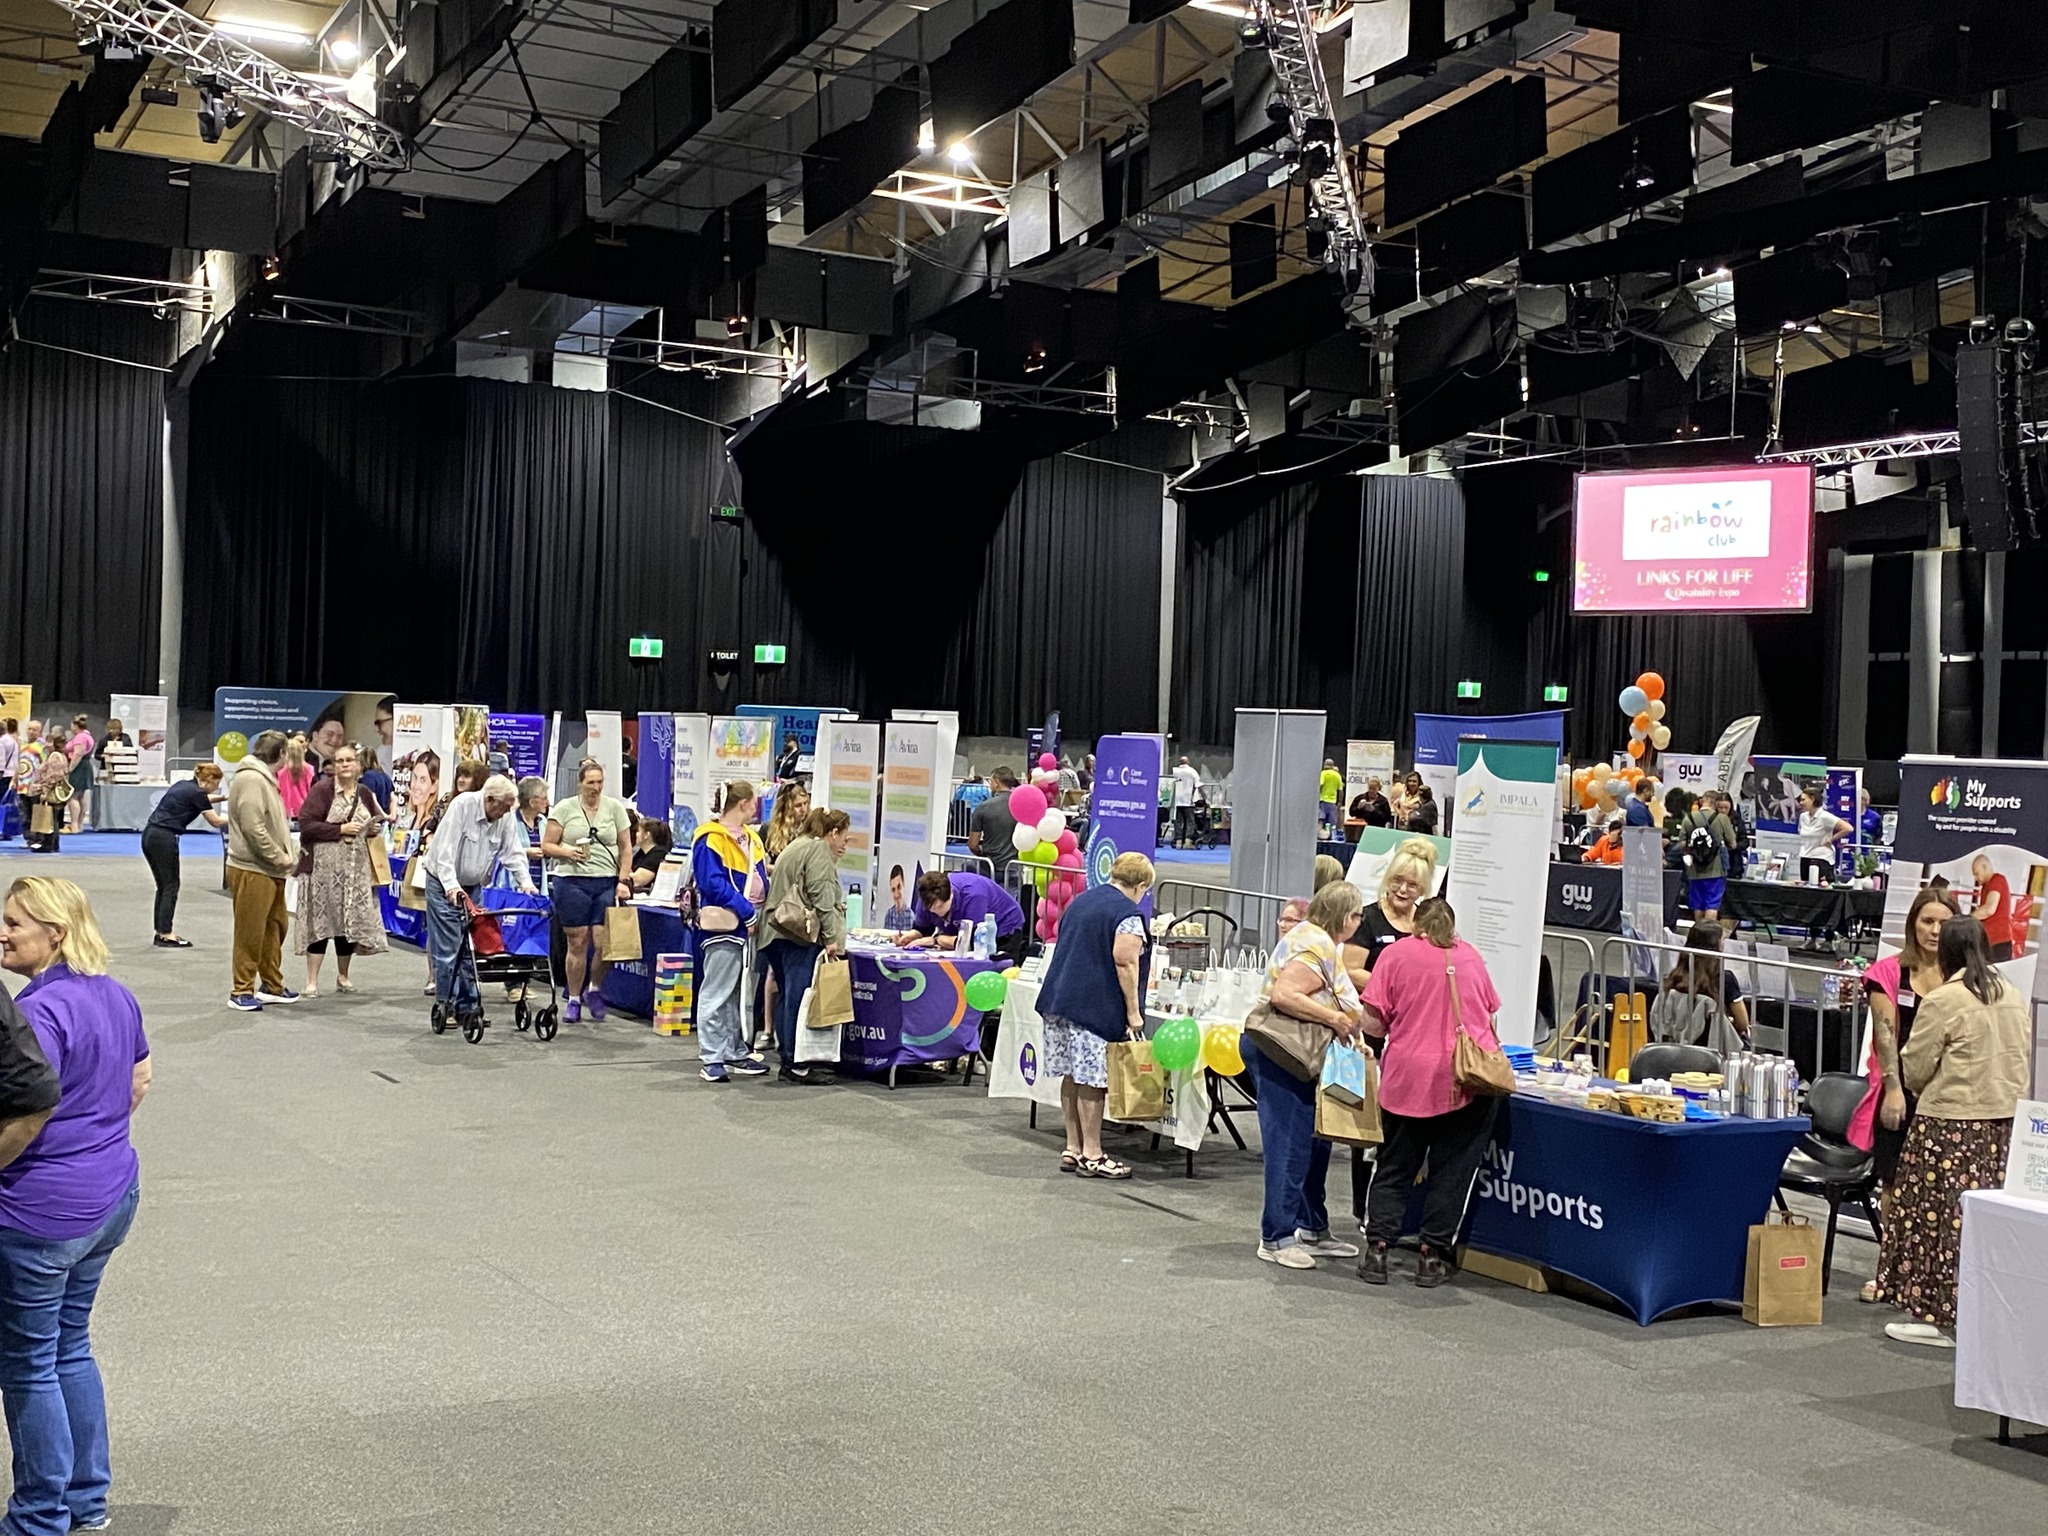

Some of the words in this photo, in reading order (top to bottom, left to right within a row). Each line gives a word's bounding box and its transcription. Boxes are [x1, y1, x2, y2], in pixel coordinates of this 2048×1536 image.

[721, 508, 737, 517] EXIT
[1650, 510, 1742, 533] rainbow
[1708, 534, 1736, 547] club
[1637, 569, 1680, 586] LINKS
[1685, 568, 1718, 585] FOR
[1723, 568, 1754, 584] LIFE
[1718, 587, 1740, 600] Expo
[717, 652, 738, 660] TOILET
[398, 714, 422, 728] APM
[1717, 742, 1736, 783] ABLES
[393, 769, 411, 782] Find
[1679, 764, 1703, 780] gw
[1966, 778, 1986, 797] My
[1499, 793, 1538, 807] IMPALA
[1964, 793, 2022, 811] Supports
[1562, 884, 1593, 906] gw
[1480, 1139, 1514, 1180] My
[1478, 1169, 1604, 1230] Supports
